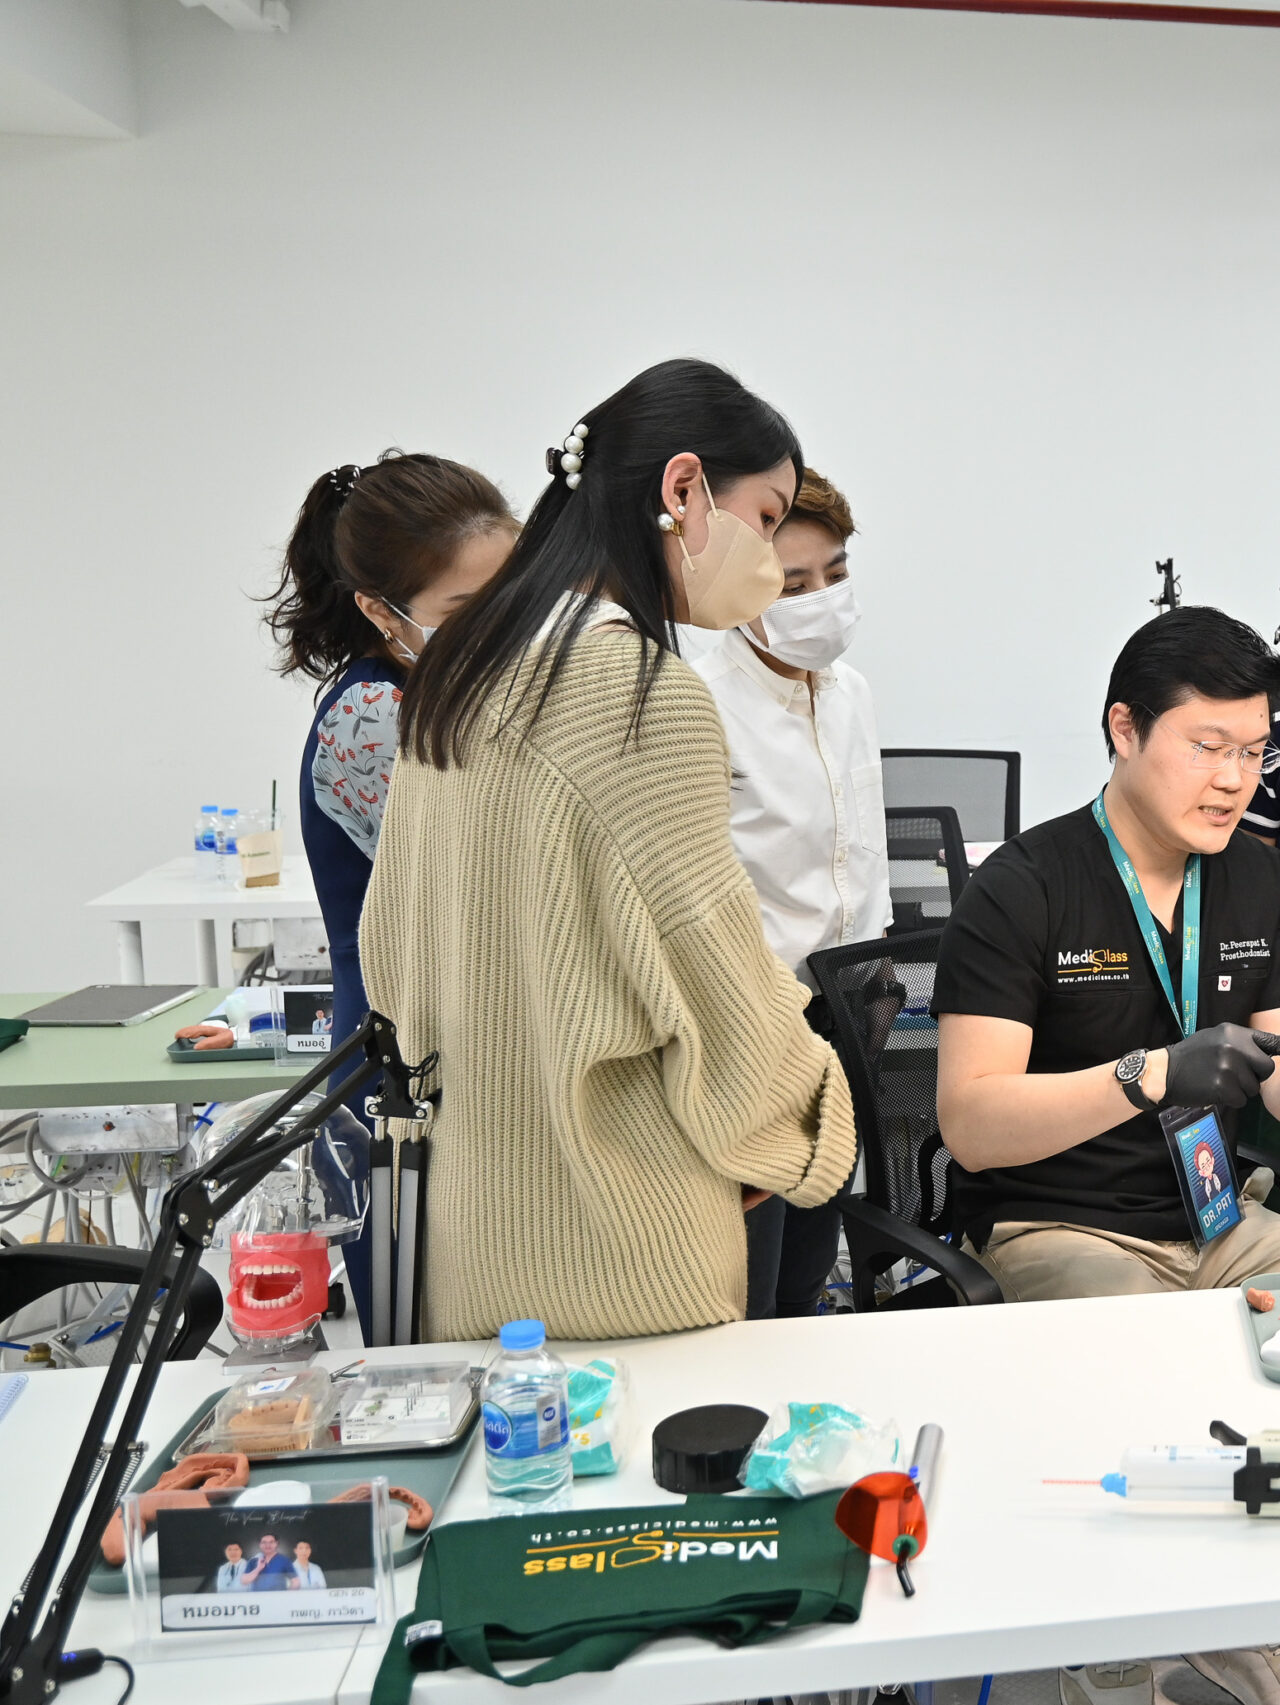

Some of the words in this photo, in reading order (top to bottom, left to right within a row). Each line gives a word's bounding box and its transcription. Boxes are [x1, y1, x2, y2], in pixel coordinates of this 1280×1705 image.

[1058, 949, 1128, 973] MediClass
[1202, 1192, 1233, 1229] DR.PAT
[531, 1516, 778, 1544] www.mediclass.co.th
